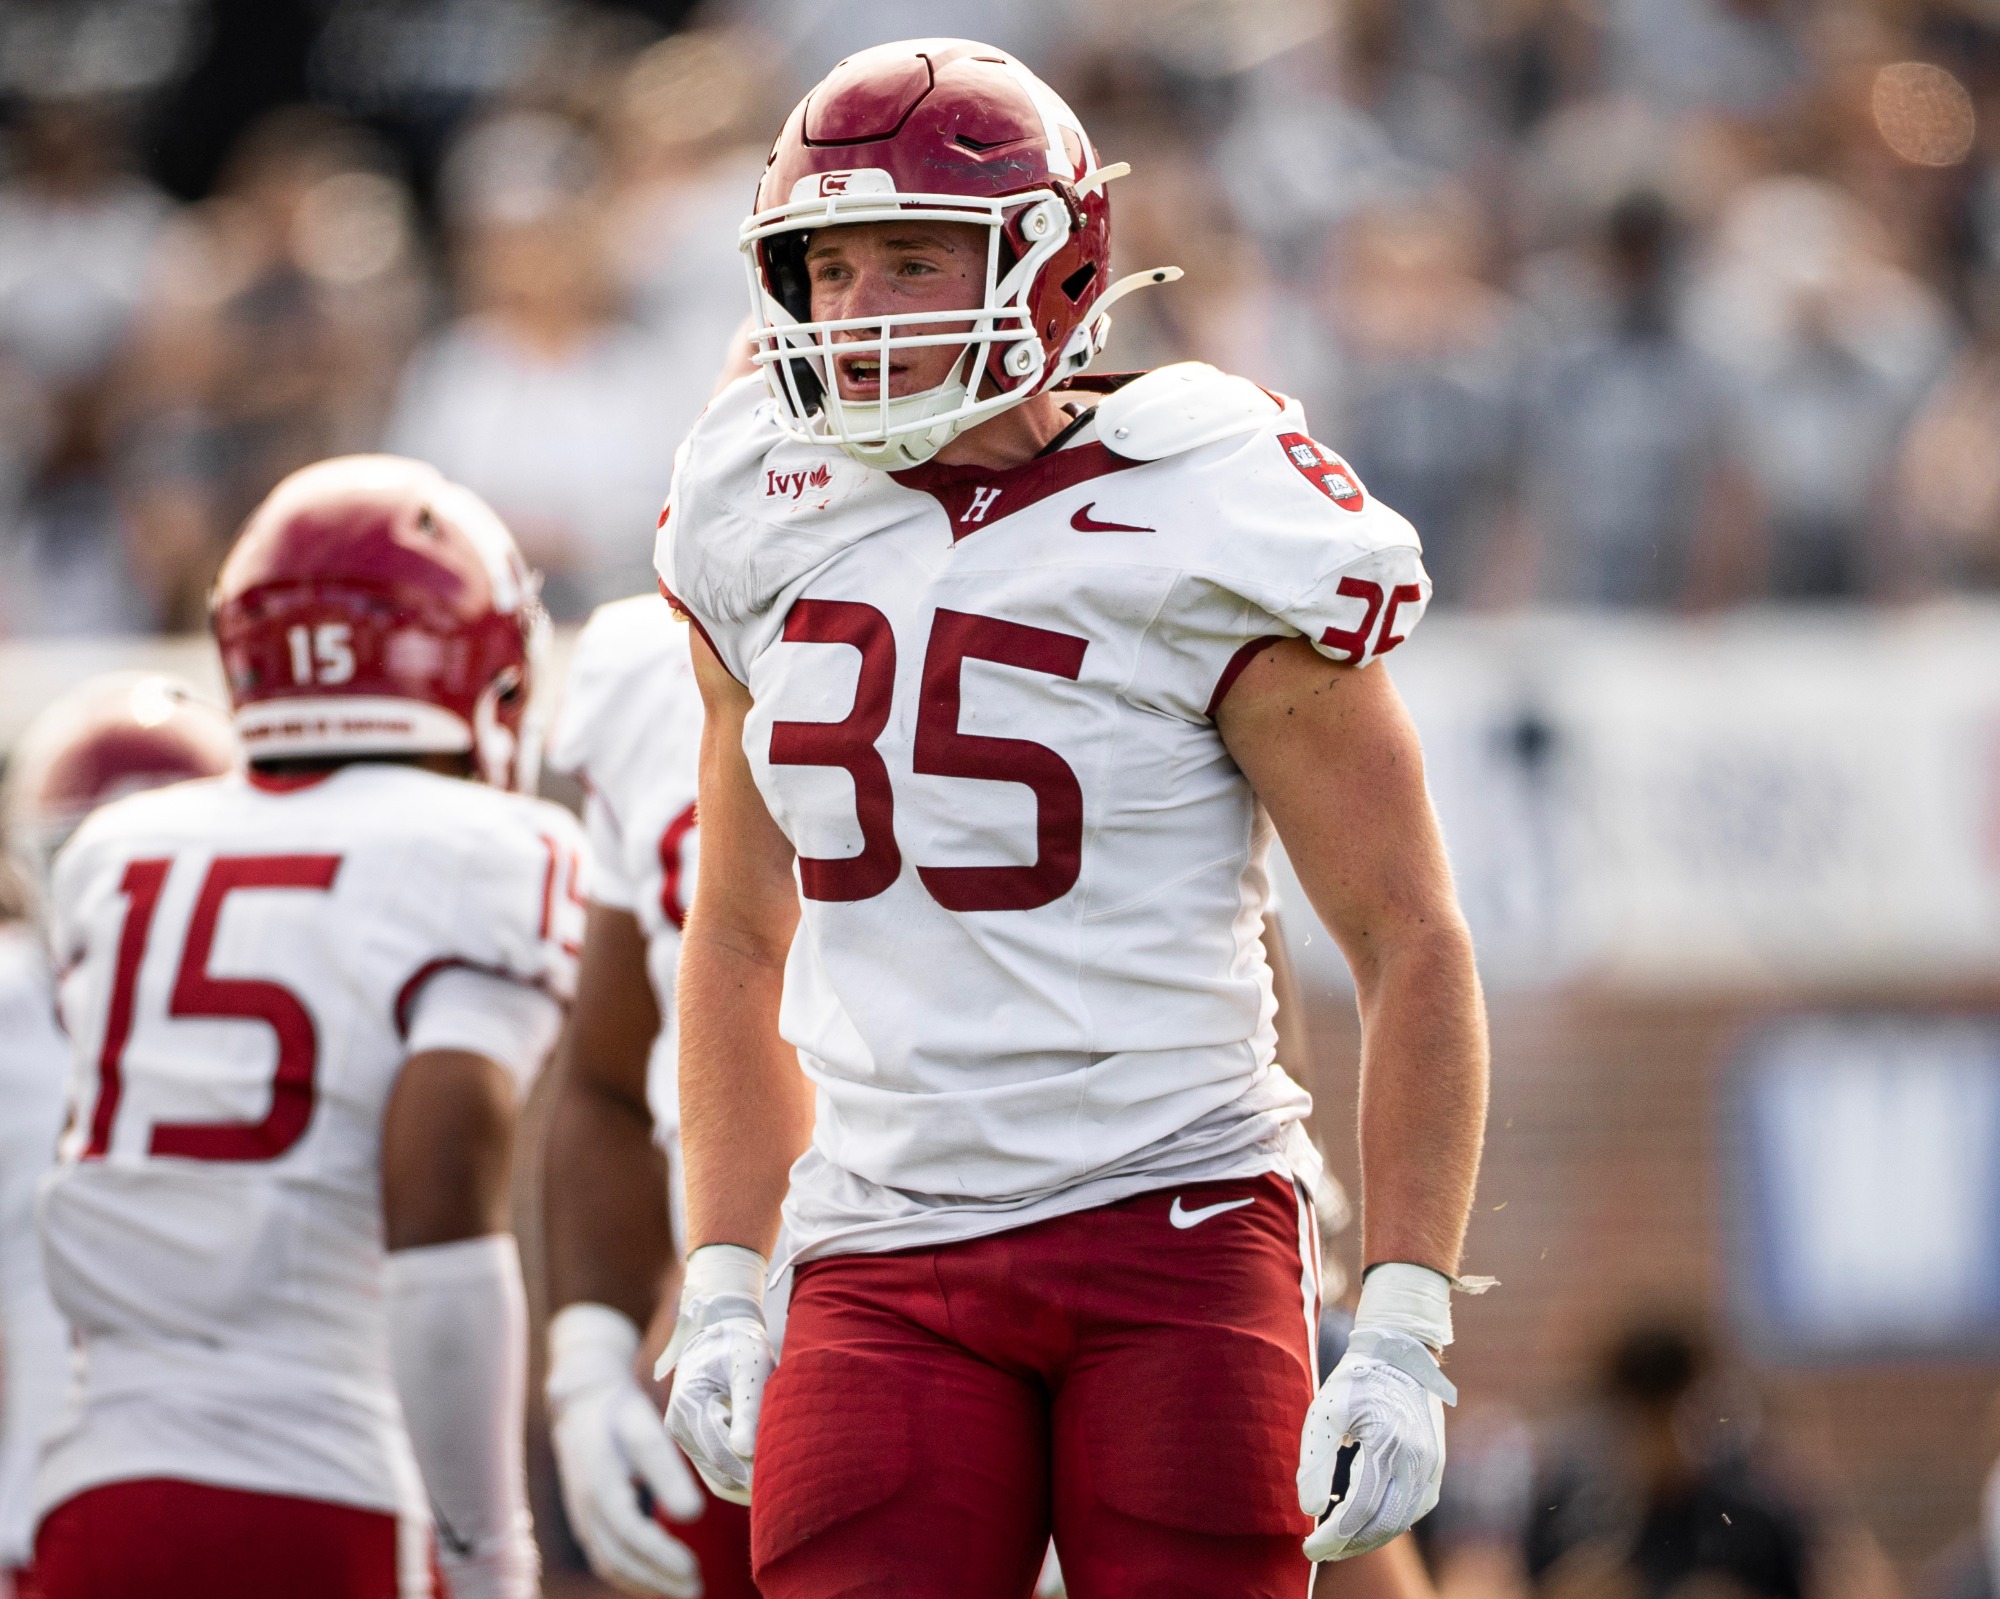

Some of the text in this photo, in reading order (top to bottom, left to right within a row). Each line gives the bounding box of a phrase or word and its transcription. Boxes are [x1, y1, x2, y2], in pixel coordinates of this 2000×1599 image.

[766, 469, 808, 500] Ivy
[960, 486, 1002, 522] H
[286, 622, 357, 685] 15
[768, 598, 1090, 913] 35
[82, 854, 345, 1162] 15
